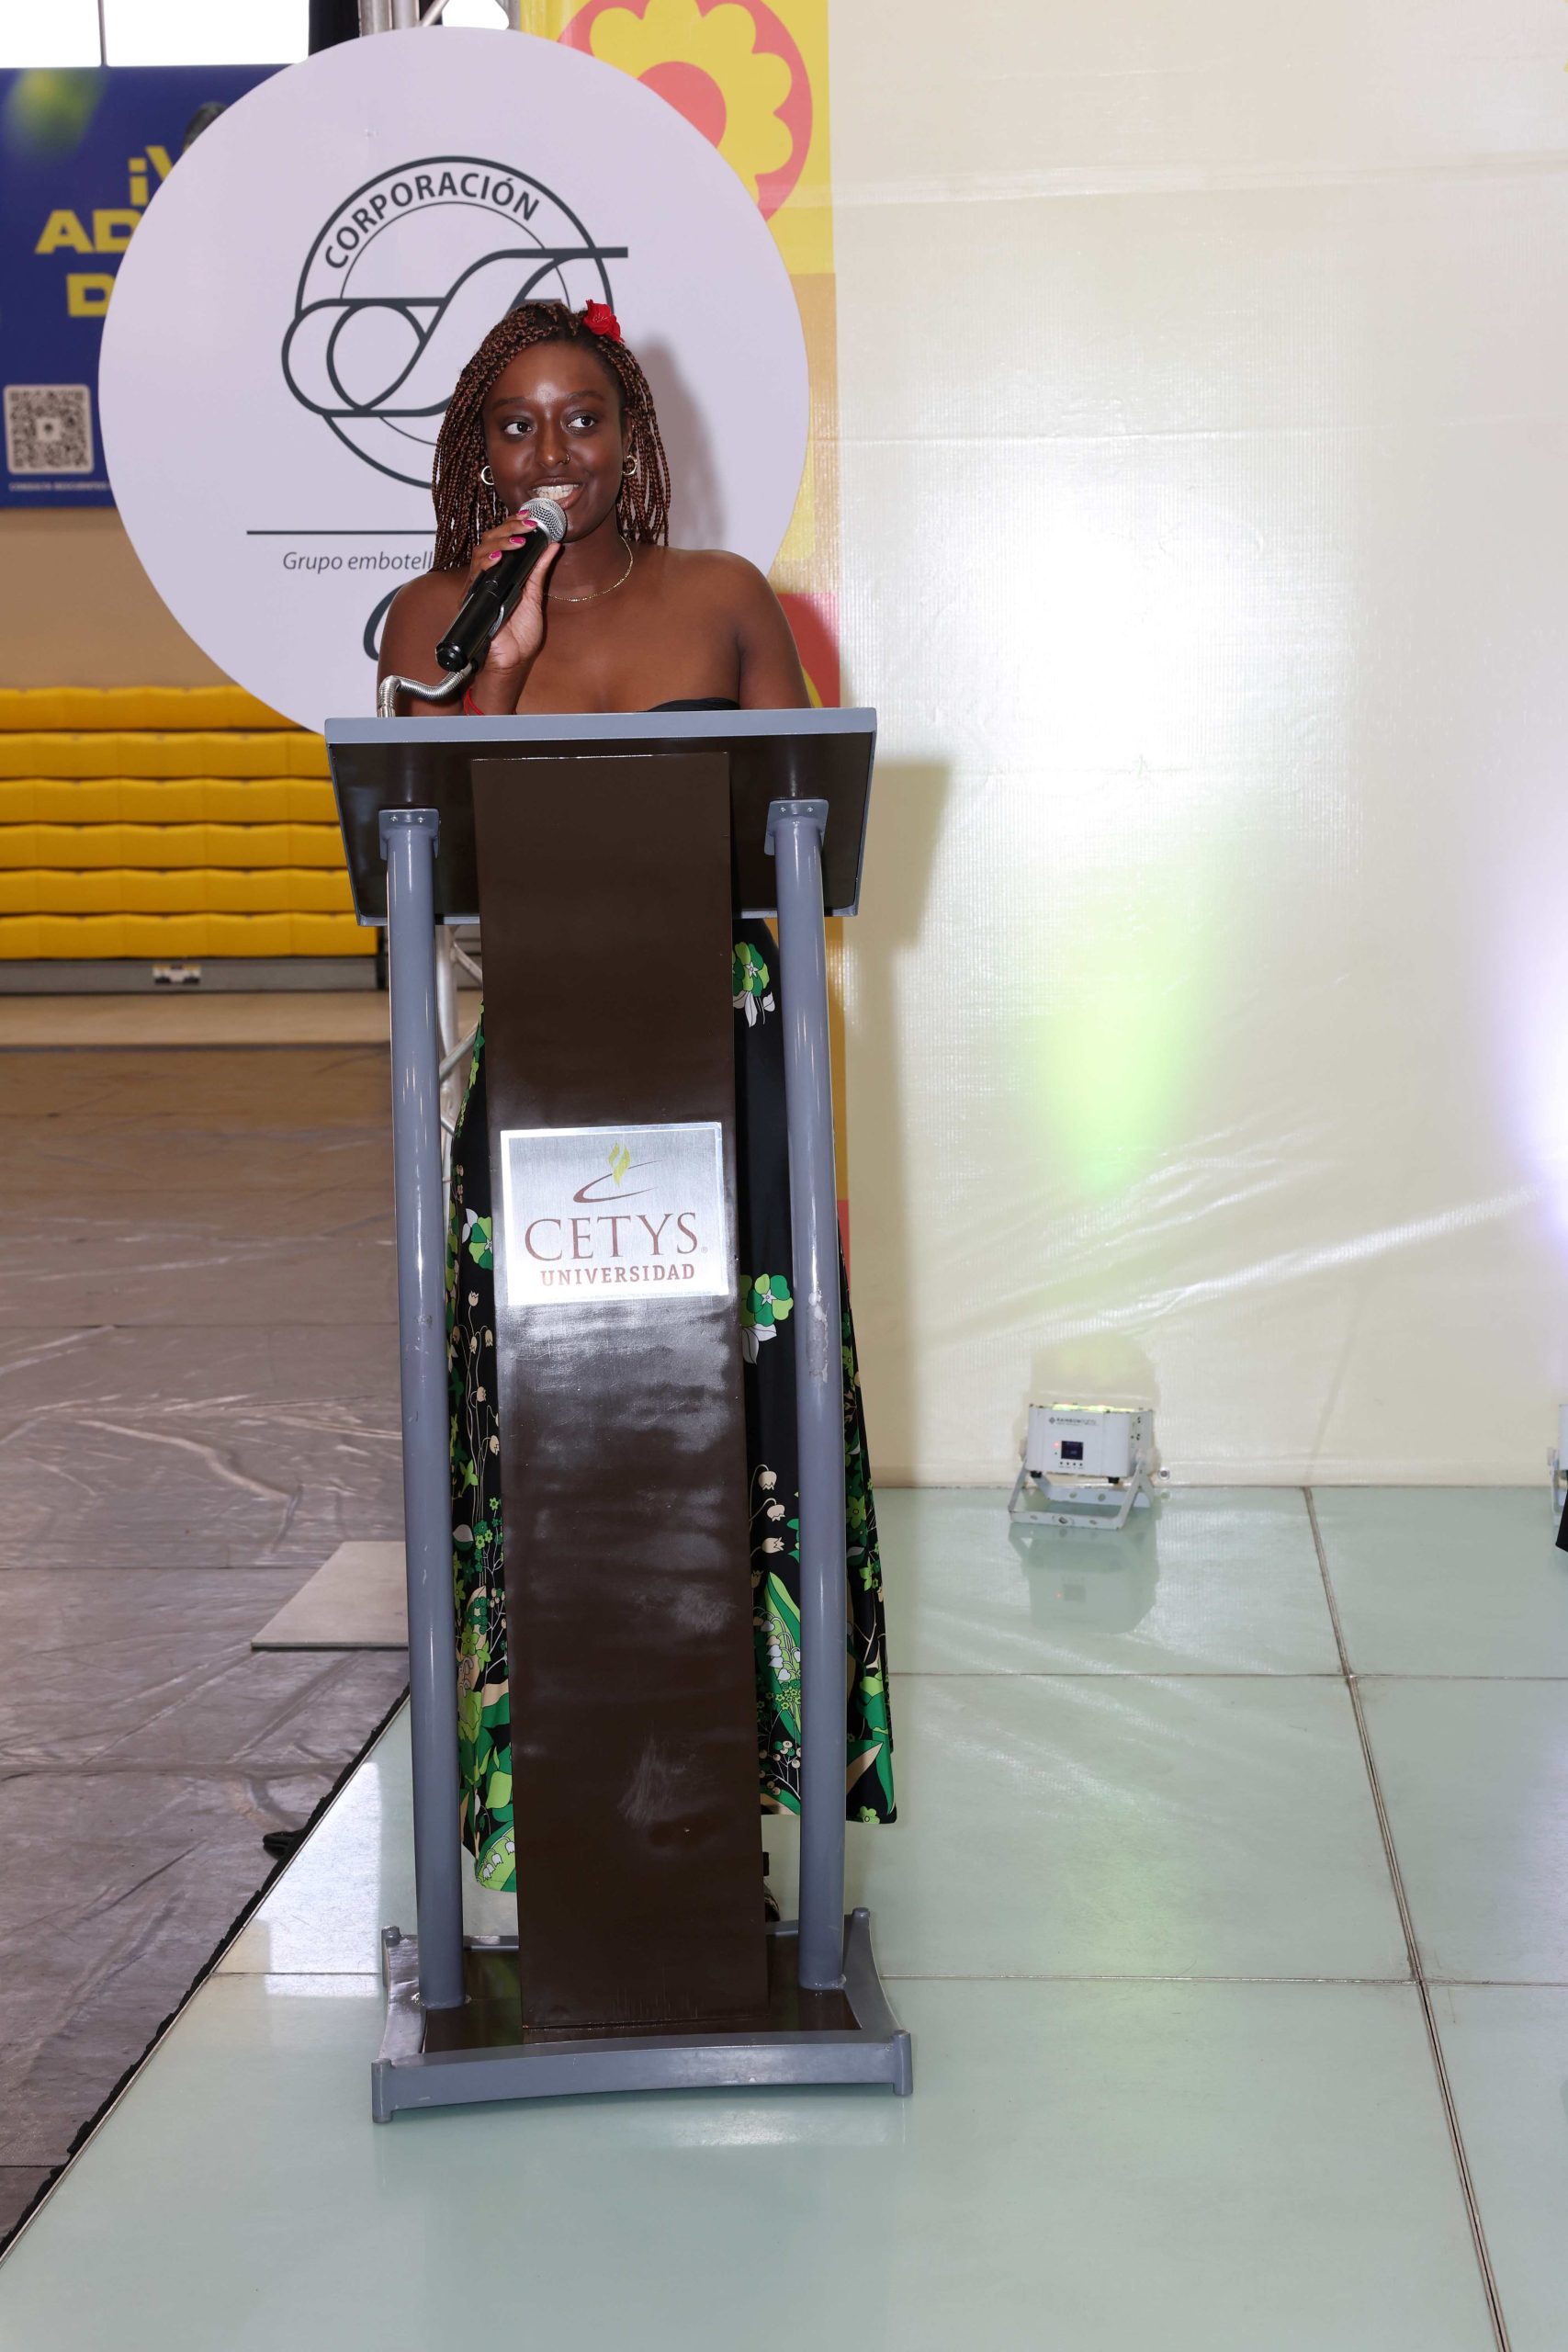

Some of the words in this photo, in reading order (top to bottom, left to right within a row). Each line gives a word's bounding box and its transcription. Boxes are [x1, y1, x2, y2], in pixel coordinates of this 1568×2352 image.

[324, 171, 540, 269] CORPORACIÓN
[282, 550, 343, 574] Grupo
[348, 550, 434, 571] embotell
[524, 1211, 699, 1261] CETYS
[540, 1263, 695, 1287] UNIVERSIDAD
